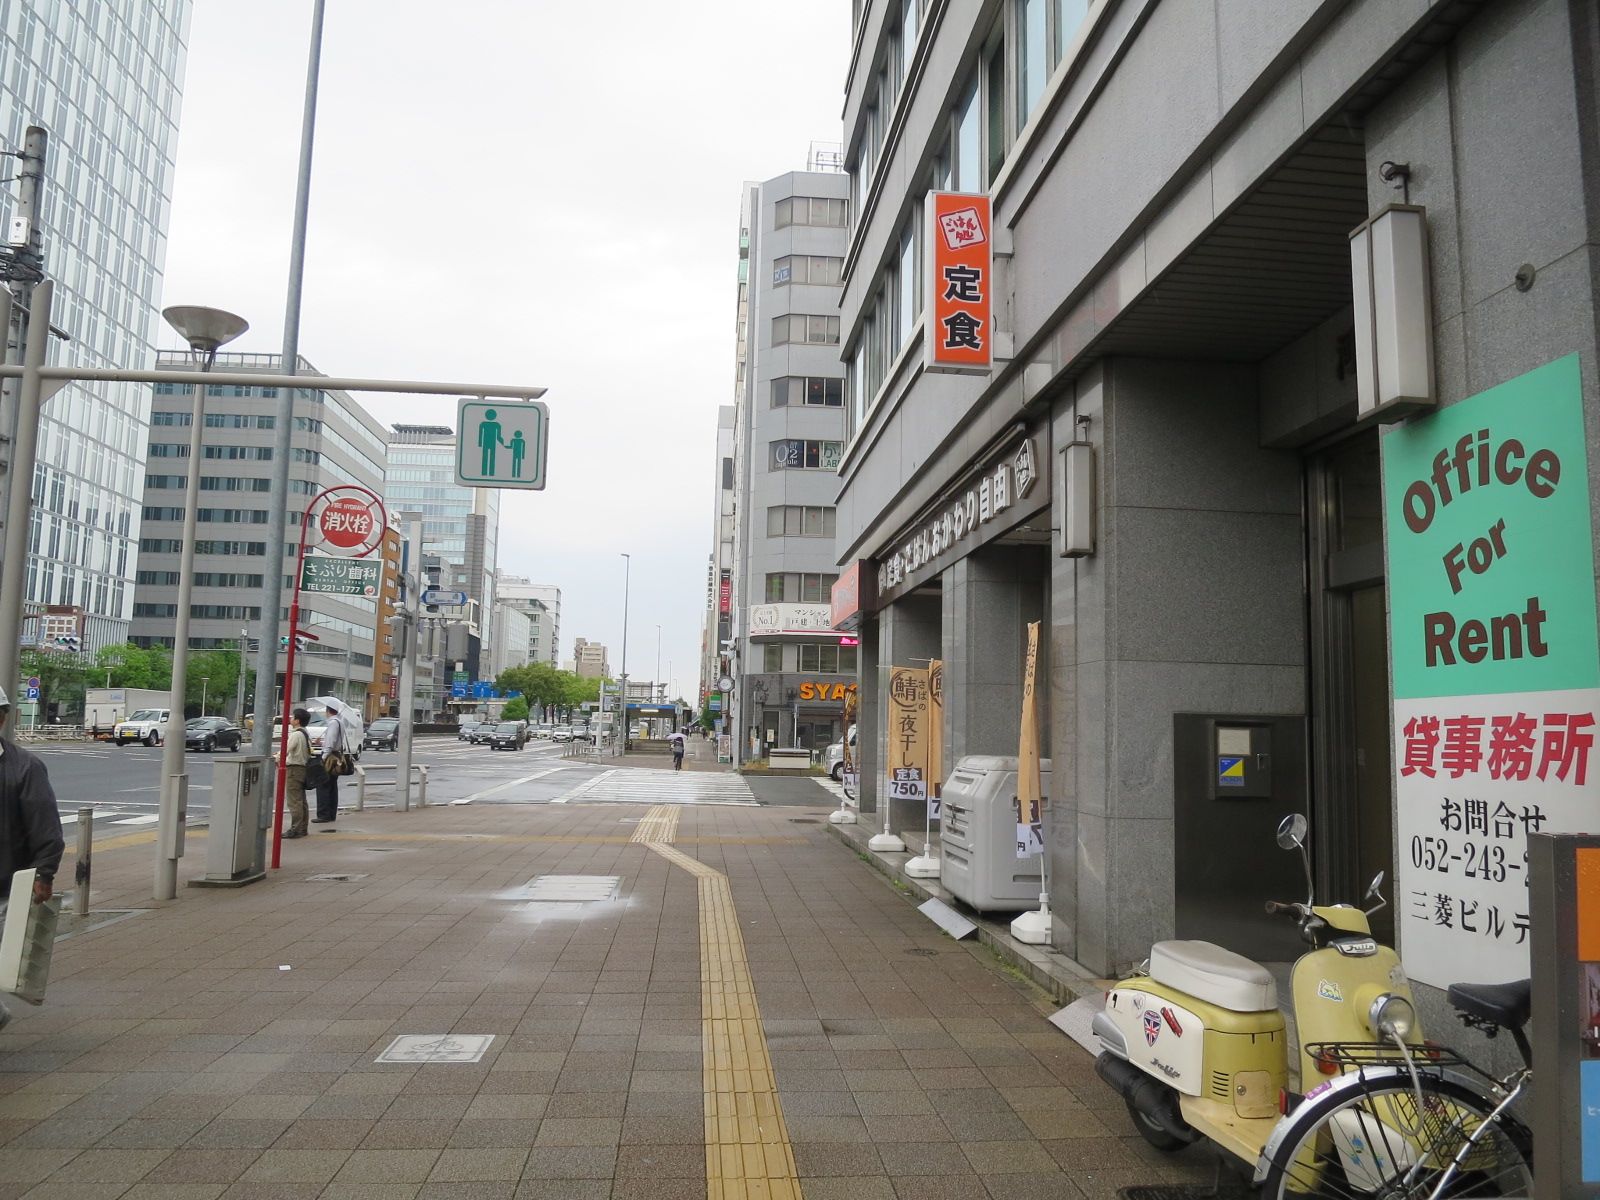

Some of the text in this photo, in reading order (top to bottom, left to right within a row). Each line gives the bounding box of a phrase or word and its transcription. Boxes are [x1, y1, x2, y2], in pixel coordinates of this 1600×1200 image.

[945, 215, 977, 233] ごはん
[942, 264, 983, 350] 定食
[1402, 428, 1561, 534] Office
[343, 503, 367, 511] HYDRANT
[324, 511, 370, 534] 消火栓
[1442, 517, 1507, 595] For
[305, 562, 377, 581] さぶり歯科
[307, 583, 361, 593] TEL 221-1777
[759, 615, 773, 625] No.1
[1423, 596, 1549, 667] Rent
[29, 690, 37, 699] P
[917, 679, 928, 711] さばの
[893, 676, 919, 768] 鯖一夜干し
[1400, 712, 1596, 786] 貸事務所
[896, 768, 920, 781] 定食
[892, 781, 924, 797] 750円
[1440, 797, 1547, 839] お問合せ
